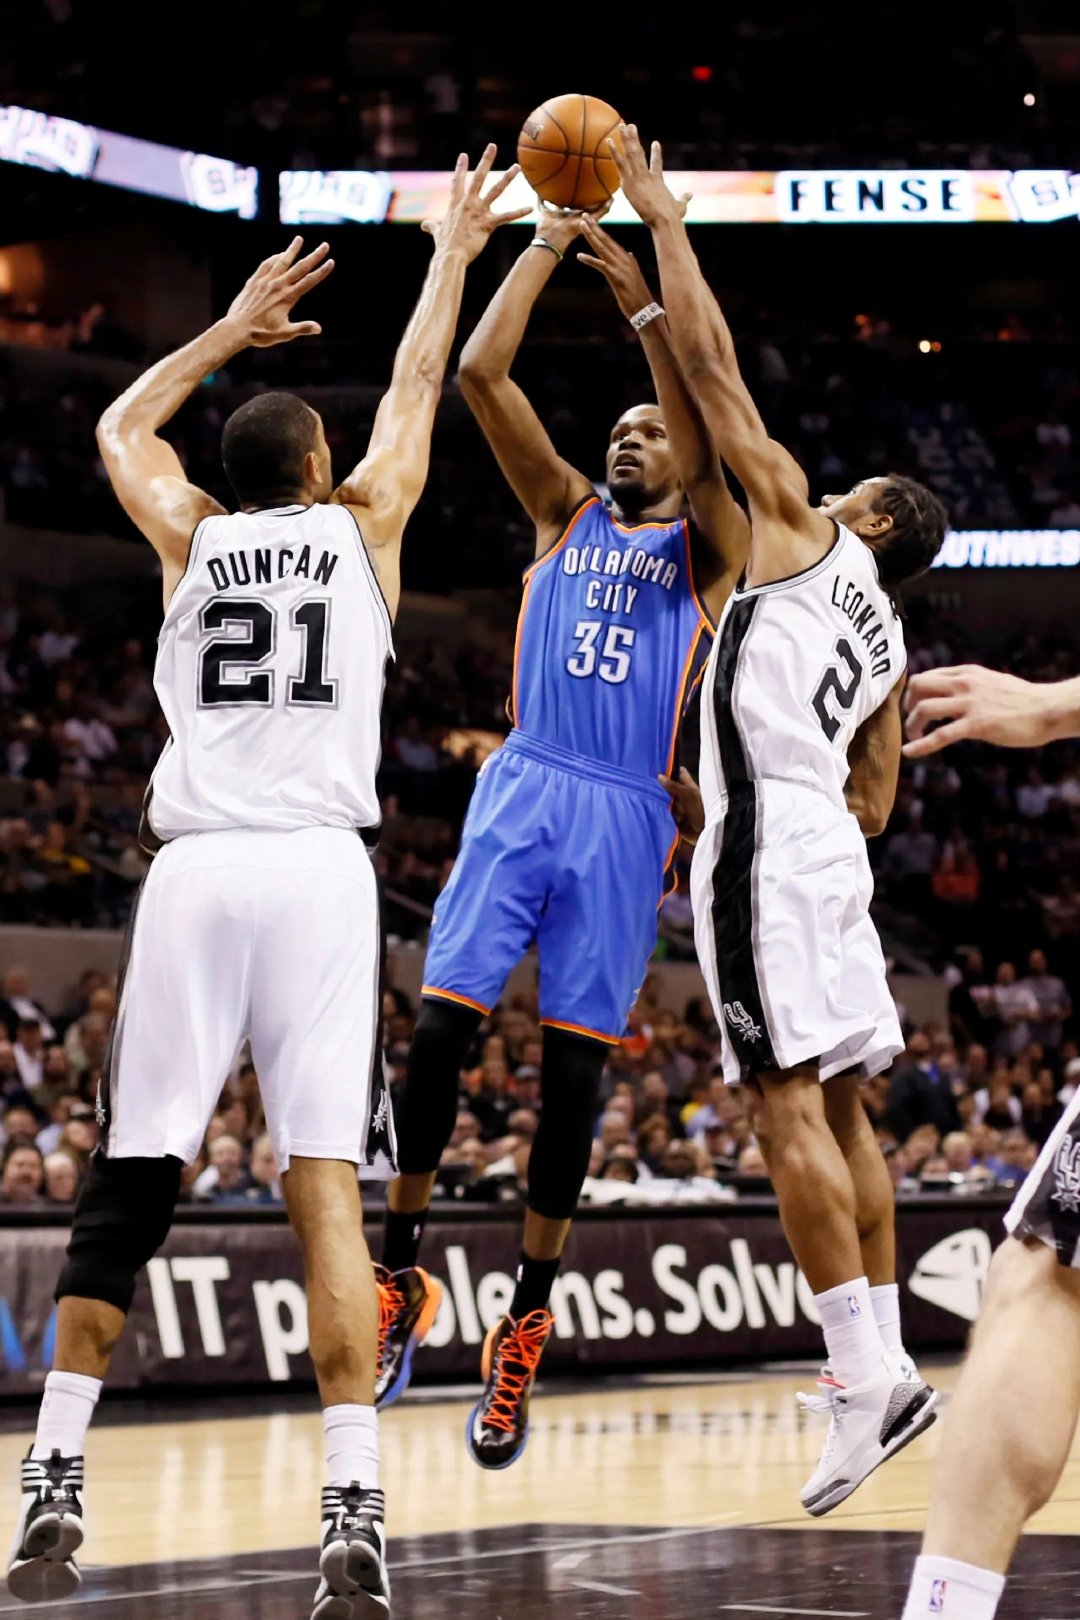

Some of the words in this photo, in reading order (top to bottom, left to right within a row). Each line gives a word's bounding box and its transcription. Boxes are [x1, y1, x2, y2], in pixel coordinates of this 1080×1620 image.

[789, 179, 963, 212] FENSE
[206, 544, 338, 591] DUNCAN
[562, 545, 679, 591] OKLAHOMA
[585, 579, 638, 614] CITY
[196, 597, 340, 710] 21
[566, 620, 636, 684] 35
[831, 575, 891, 679] LEONARD
[808, 634, 864, 744] 2
[147, 1256, 231, 1359] IT
[652, 1238, 822, 1335] Solv
